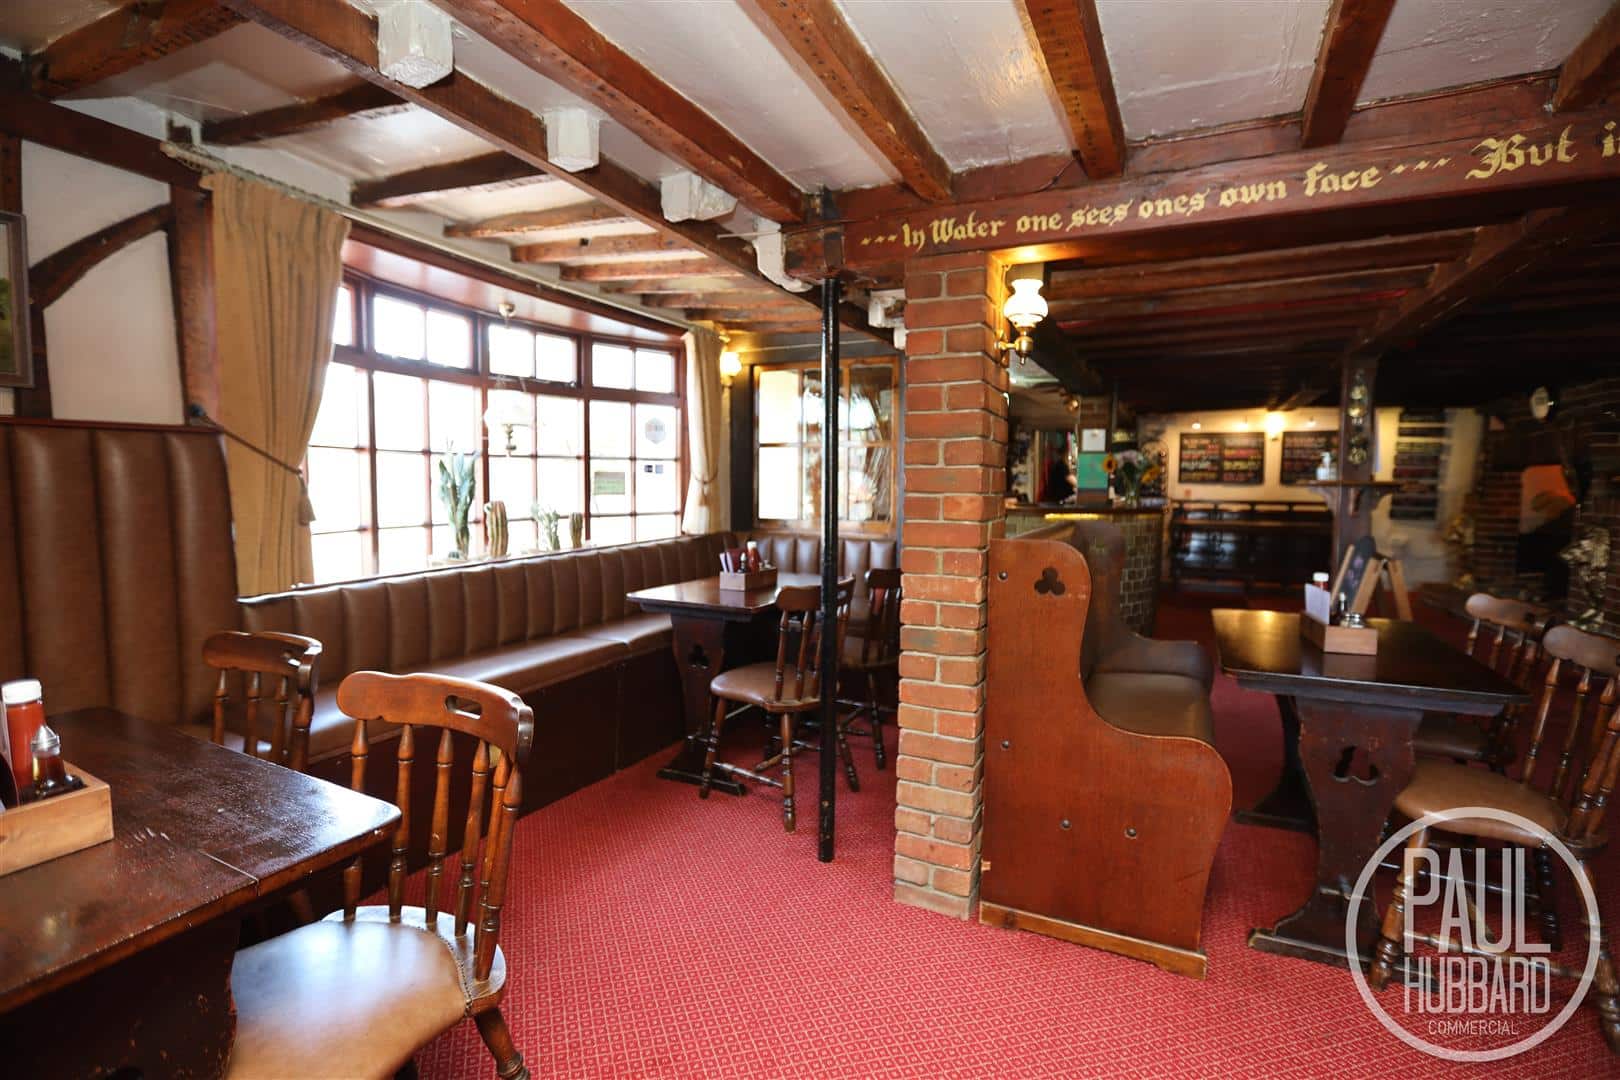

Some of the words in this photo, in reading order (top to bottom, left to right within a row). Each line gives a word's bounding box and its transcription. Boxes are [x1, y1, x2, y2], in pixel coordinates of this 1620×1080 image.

[929, 210, 1007, 245] Water
[1016, 212, 1063, 233] one
[1066, 200, 1133, 231] sees
[1138, 188, 1210, 218] ones
[1219, 180, 1287, 207] own
[1303, 161, 1383, 197] face
[1464, 124, 1579, 180] But
